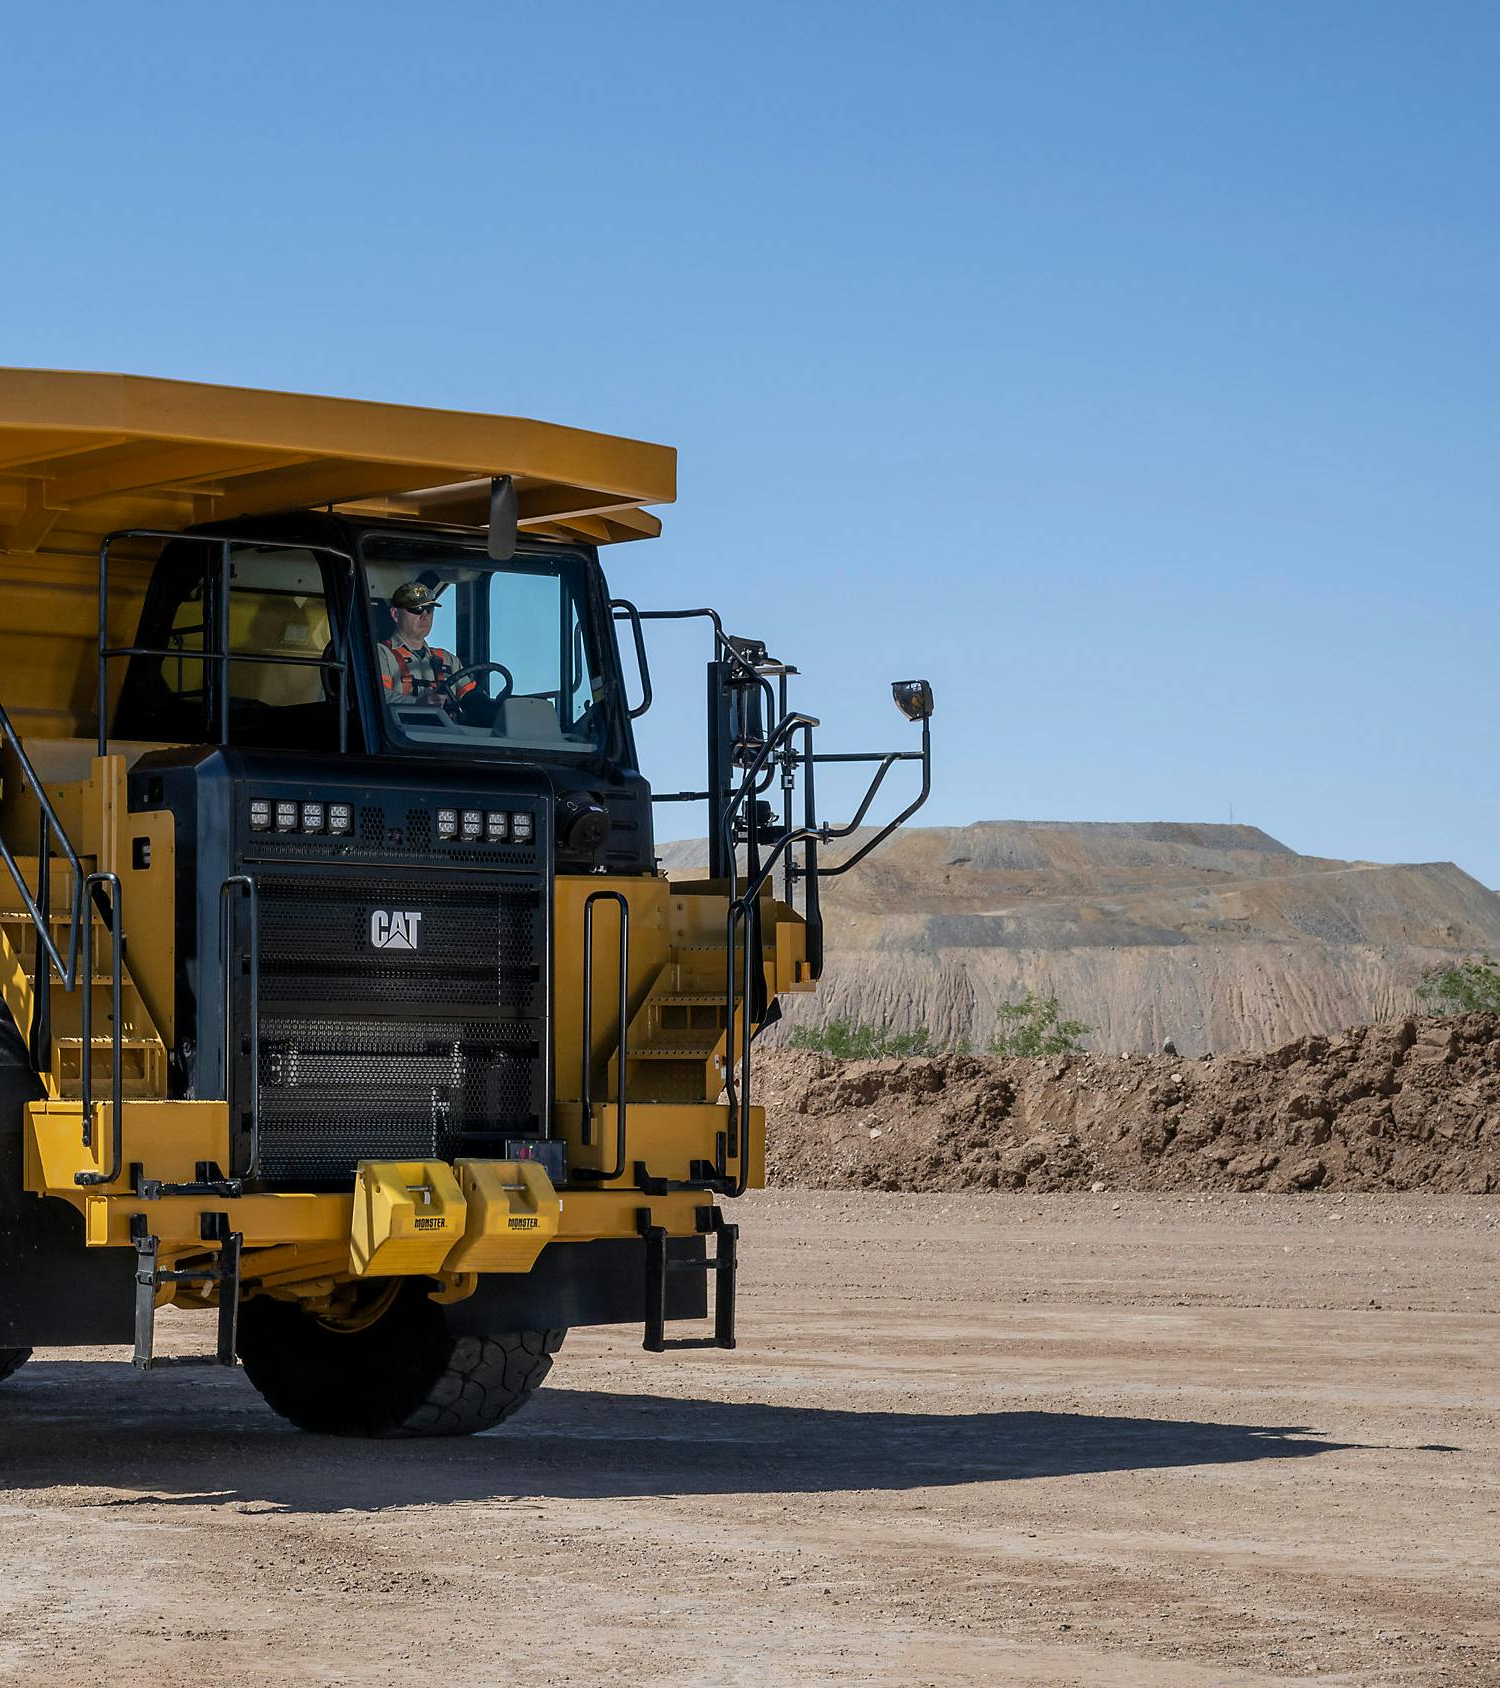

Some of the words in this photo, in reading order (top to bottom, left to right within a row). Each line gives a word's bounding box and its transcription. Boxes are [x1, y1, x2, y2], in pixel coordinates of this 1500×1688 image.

[372, 910, 421, 949] CAT
[414, 1218, 446, 1228] MONSTER
[508, 1218, 539, 1228] MONSTER
